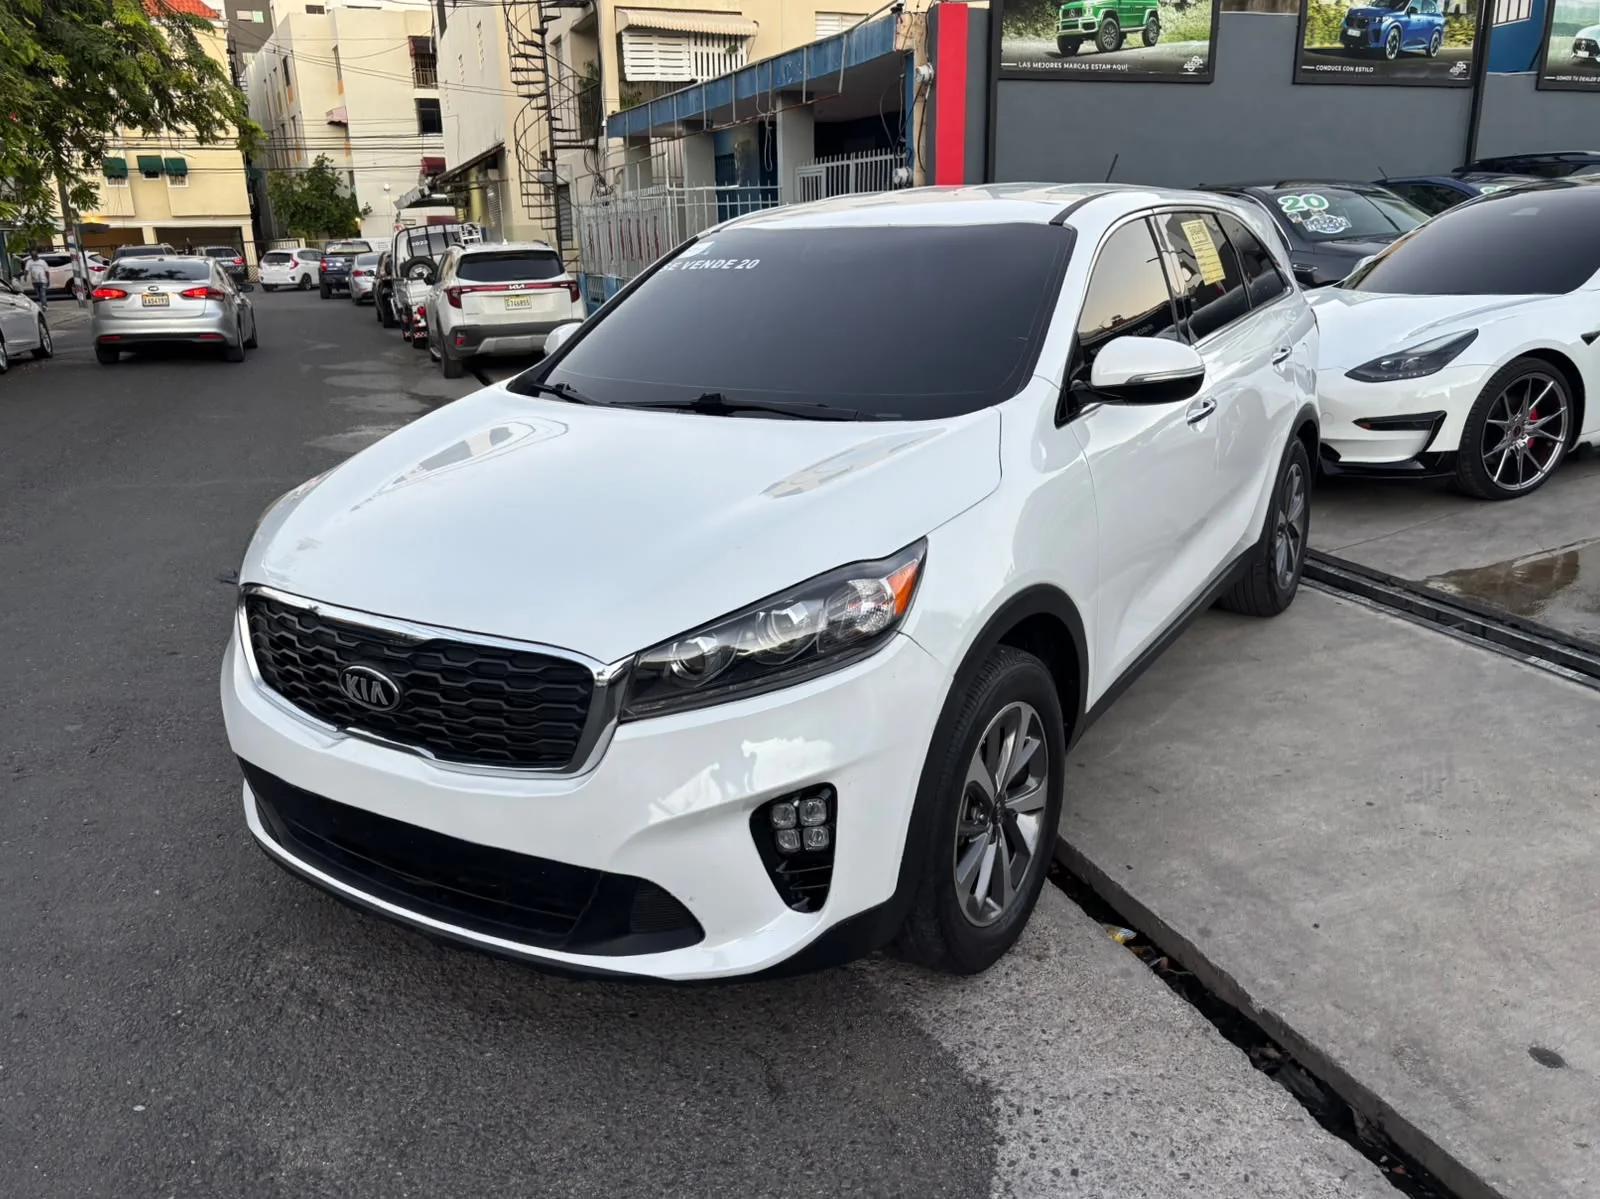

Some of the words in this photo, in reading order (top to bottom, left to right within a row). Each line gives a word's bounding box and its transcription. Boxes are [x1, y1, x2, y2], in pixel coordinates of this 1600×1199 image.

[1278, 194, 1329, 212] 20
[681, 259, 738, 270] VENDE
[734, 259, 760, 270] 20
[345, 673, 389, 705] KIA
